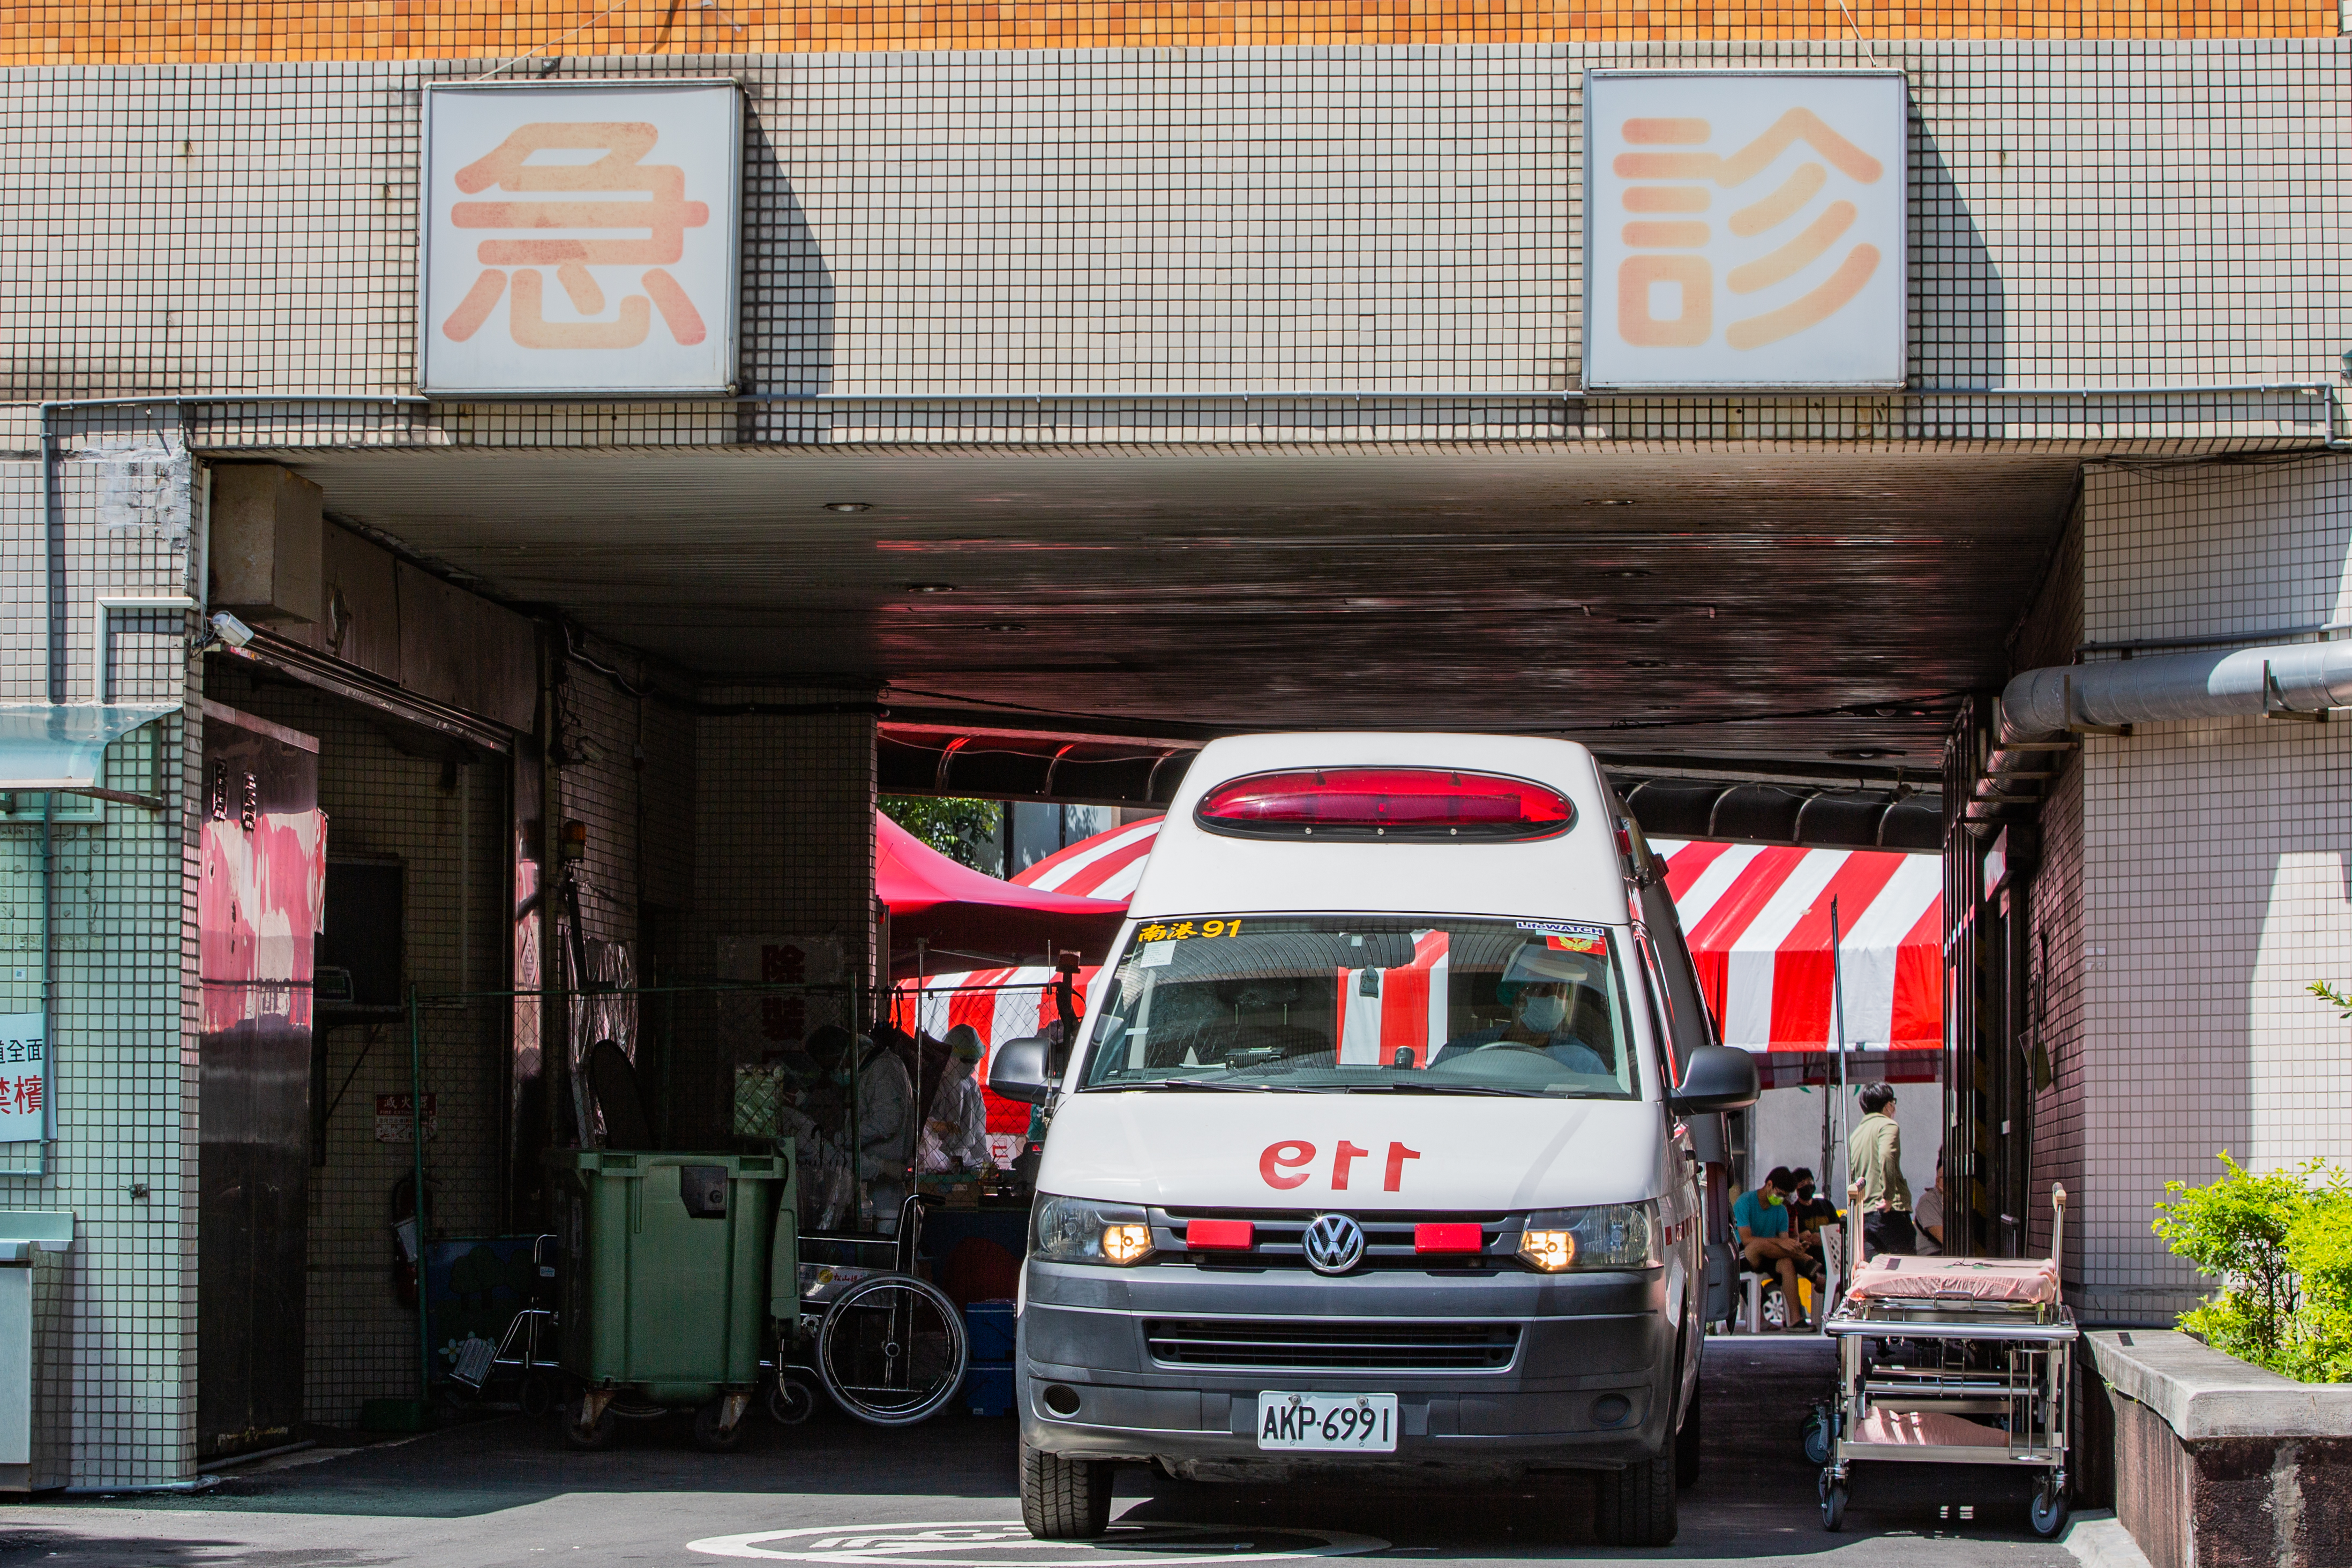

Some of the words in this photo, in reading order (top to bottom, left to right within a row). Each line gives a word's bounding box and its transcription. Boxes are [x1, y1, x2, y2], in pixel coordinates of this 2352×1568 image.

[442, 122, 710, 350] 急
[1613, 106, 1884, 351] 診
[1138, 921, 1198, 942] 南港
[1201, 920, 1242, 938] 91
[1517, 922, 1603, 935] LifeWATCH
[1262, 1405, 1389, 1442] AKP-6991
